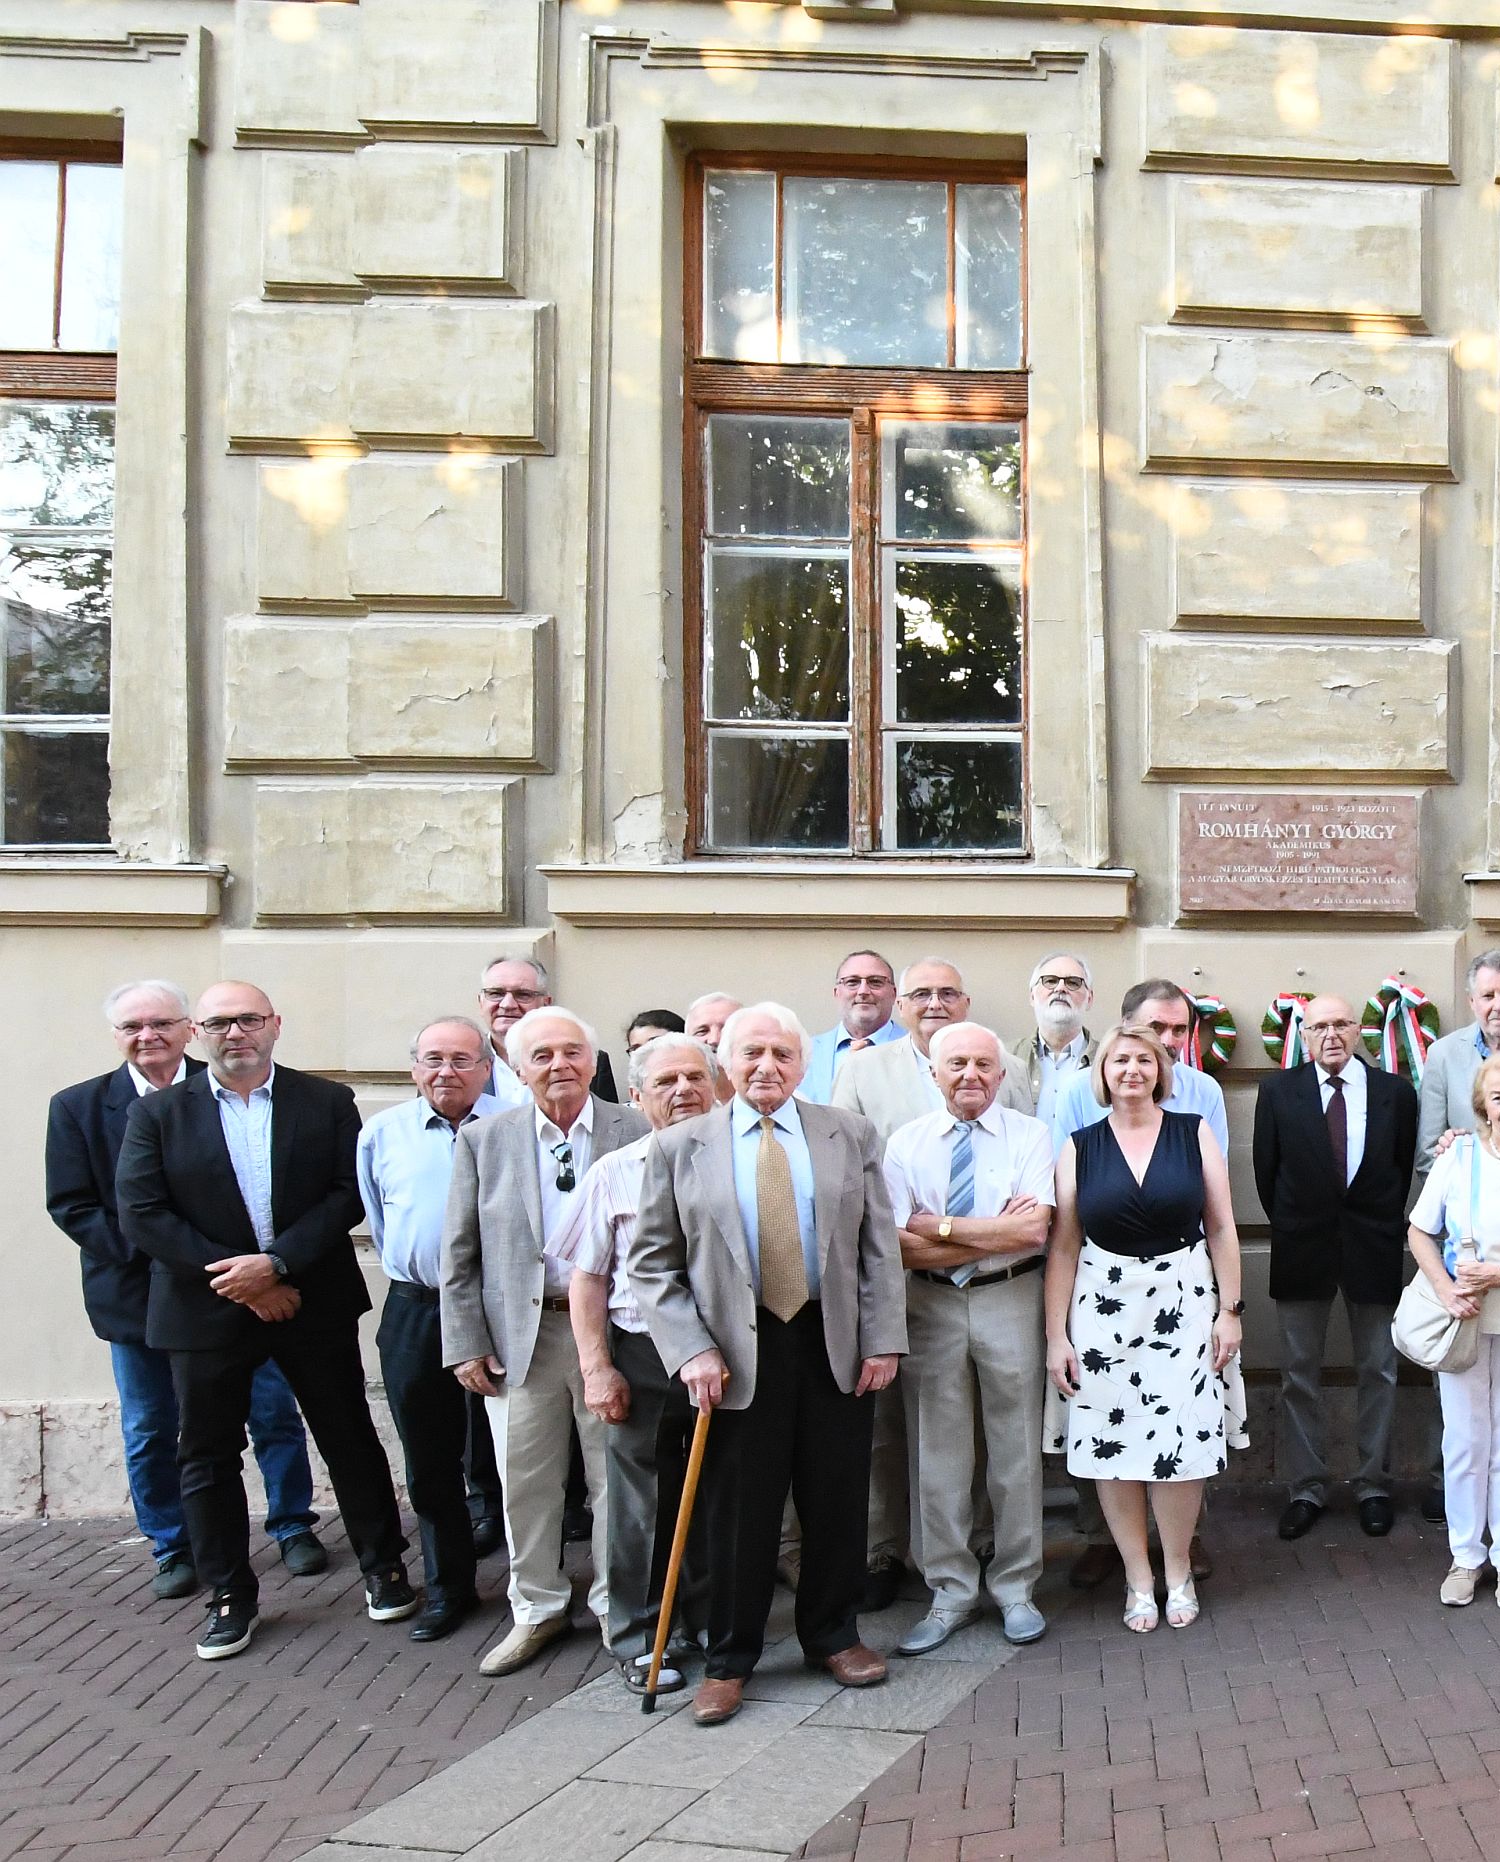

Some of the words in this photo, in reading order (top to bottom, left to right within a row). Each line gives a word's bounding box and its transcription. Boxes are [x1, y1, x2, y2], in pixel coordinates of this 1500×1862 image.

[1198, 818, 1311, 838] ROMHÁNYI
[1322, 821, 1397, 839] GYÖRGY
[1303, 851, 1320, 859] 1991
